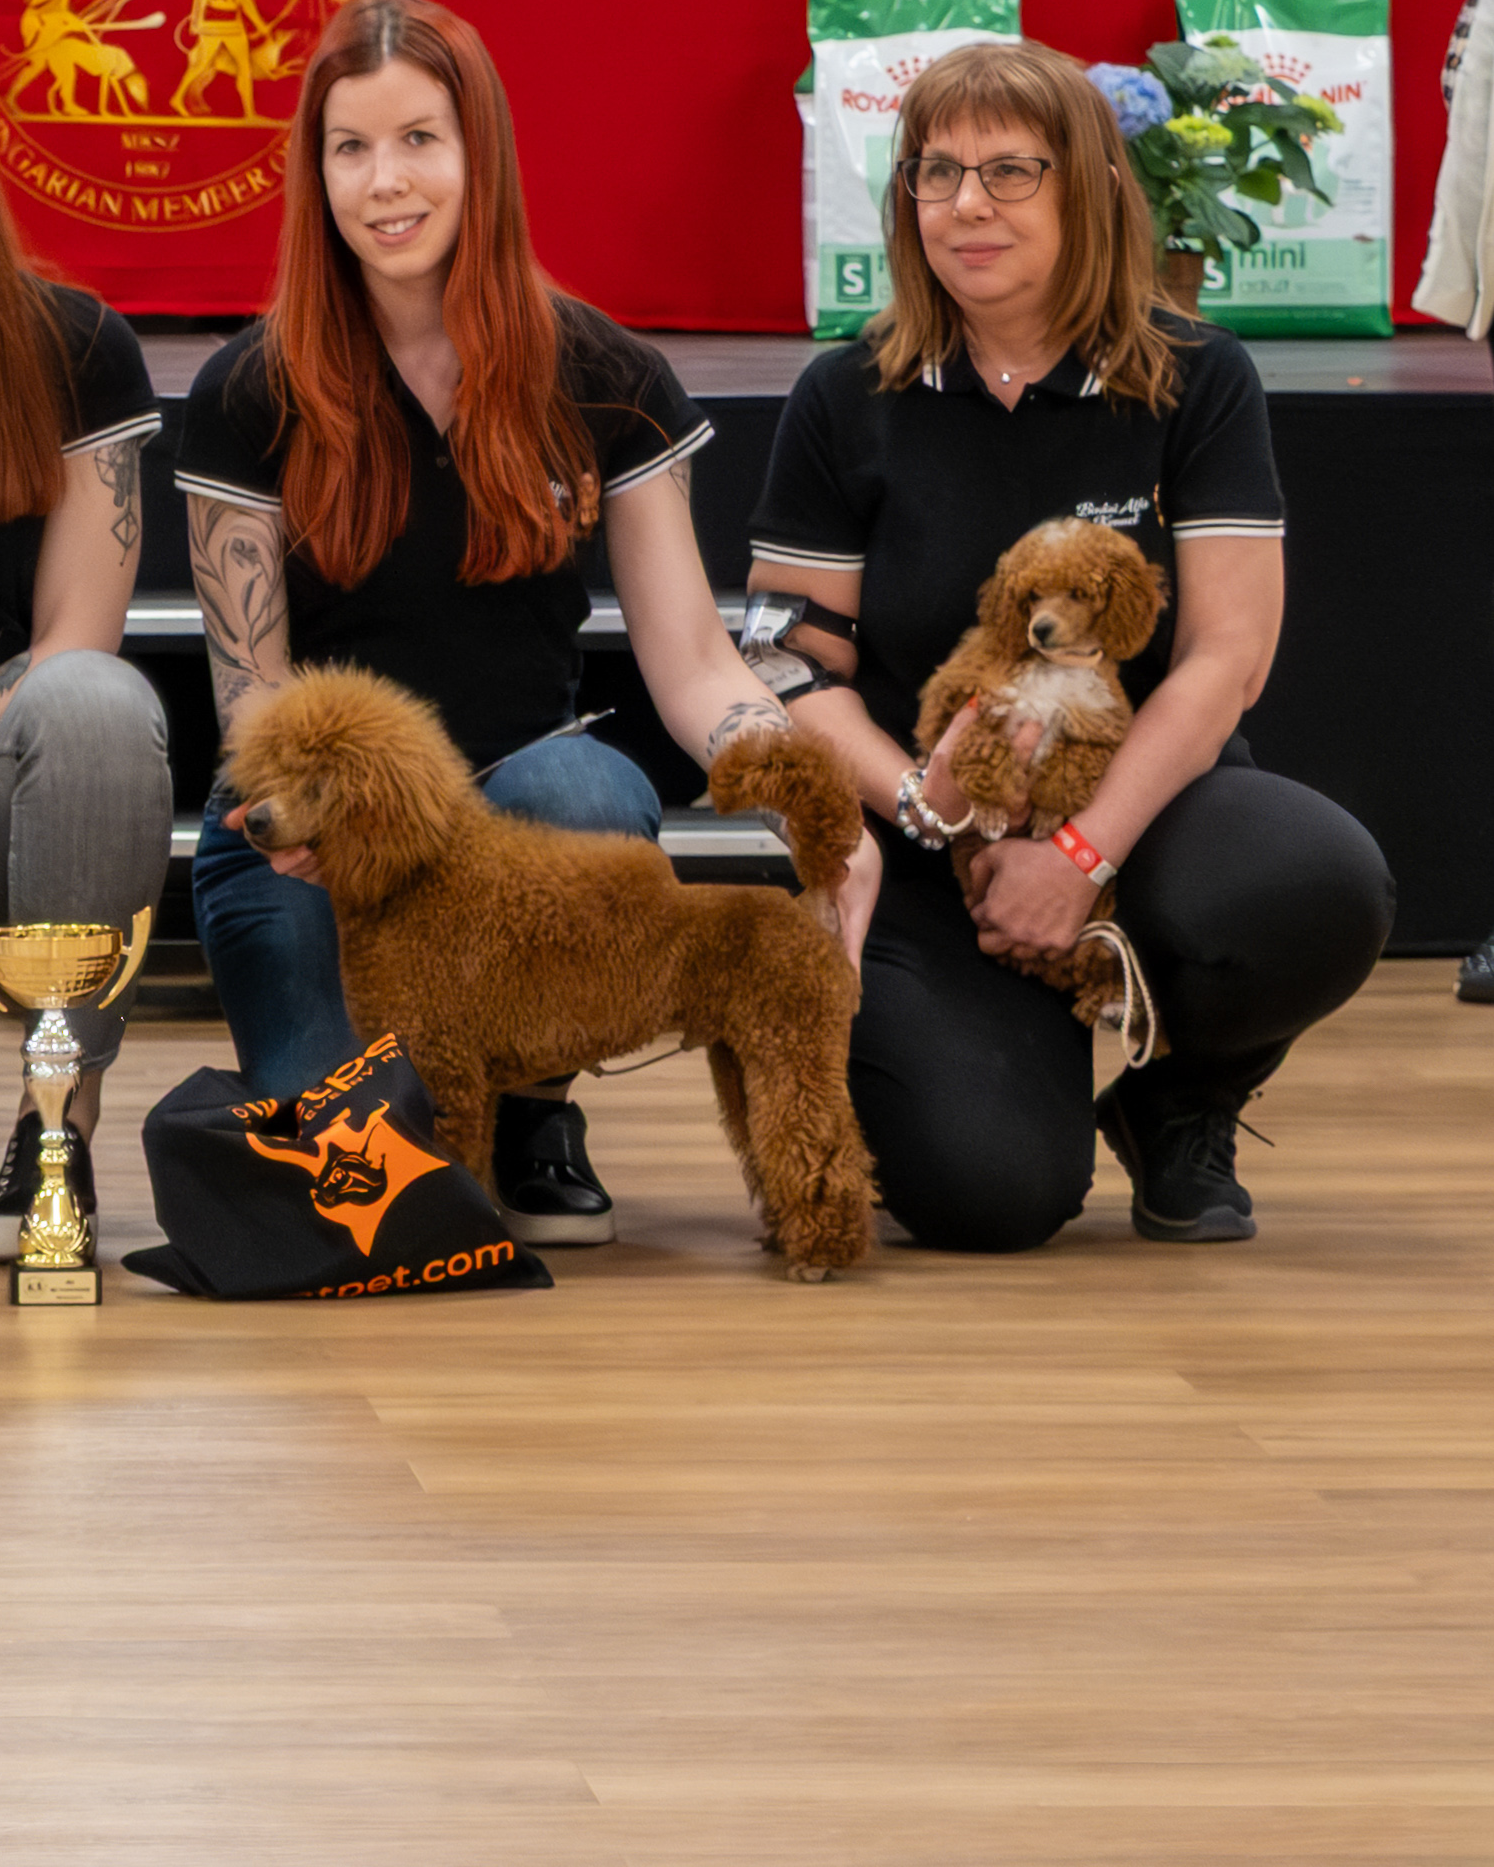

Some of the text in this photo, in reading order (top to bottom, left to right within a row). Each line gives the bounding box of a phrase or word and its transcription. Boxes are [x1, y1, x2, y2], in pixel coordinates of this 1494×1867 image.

[841, 89, 902, 112] ROYA
[1320, 82, 1363, 105] NIN
[131, 167, 274, 222] MEMBER
[1240, 242, 1306, 269] mini
[843, 263, 865, 295] S
[289, 1240, 515, 1298] pet.com
